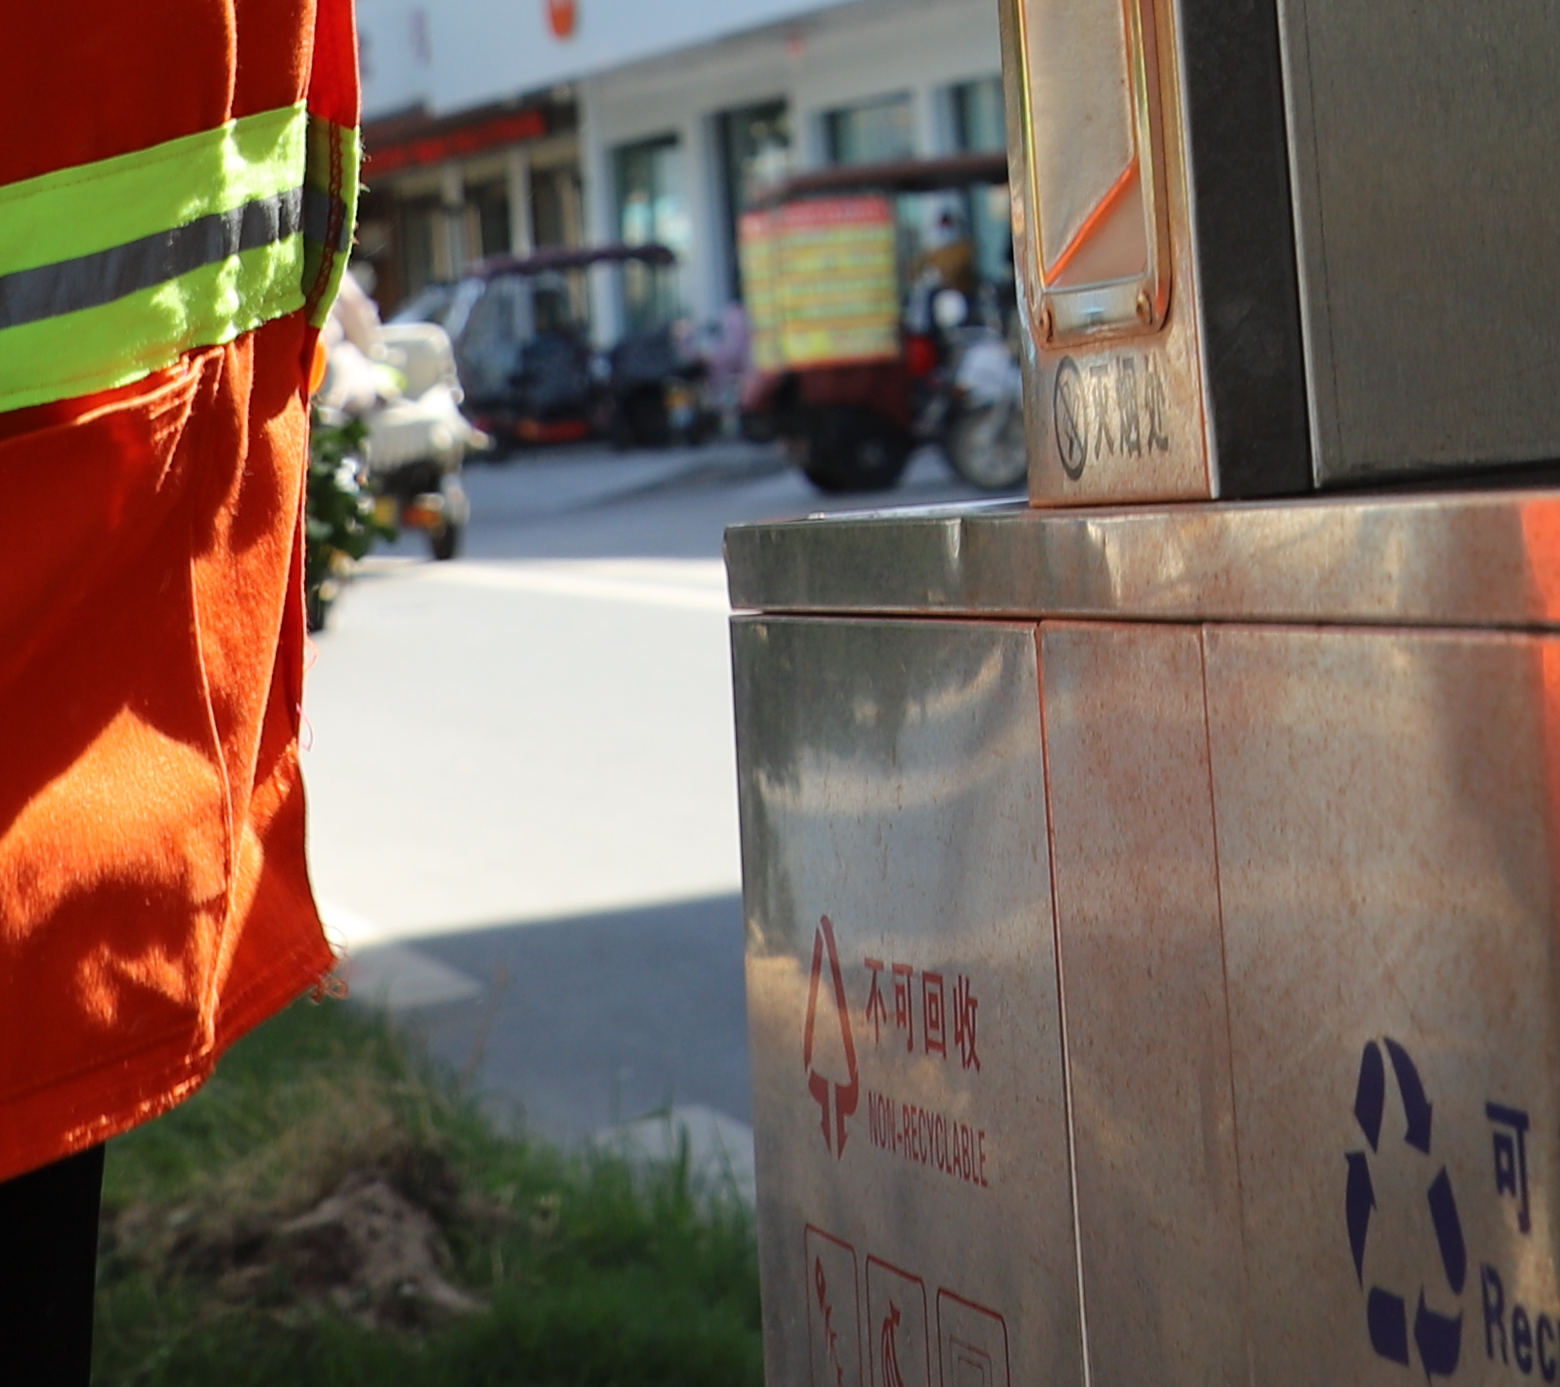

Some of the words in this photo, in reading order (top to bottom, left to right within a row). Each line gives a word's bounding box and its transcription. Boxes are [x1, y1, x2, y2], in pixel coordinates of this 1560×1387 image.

[863, 956, 981, 1076] 不可回收
[867, 1088, 989, 1189] NON-RECYCLABLE
